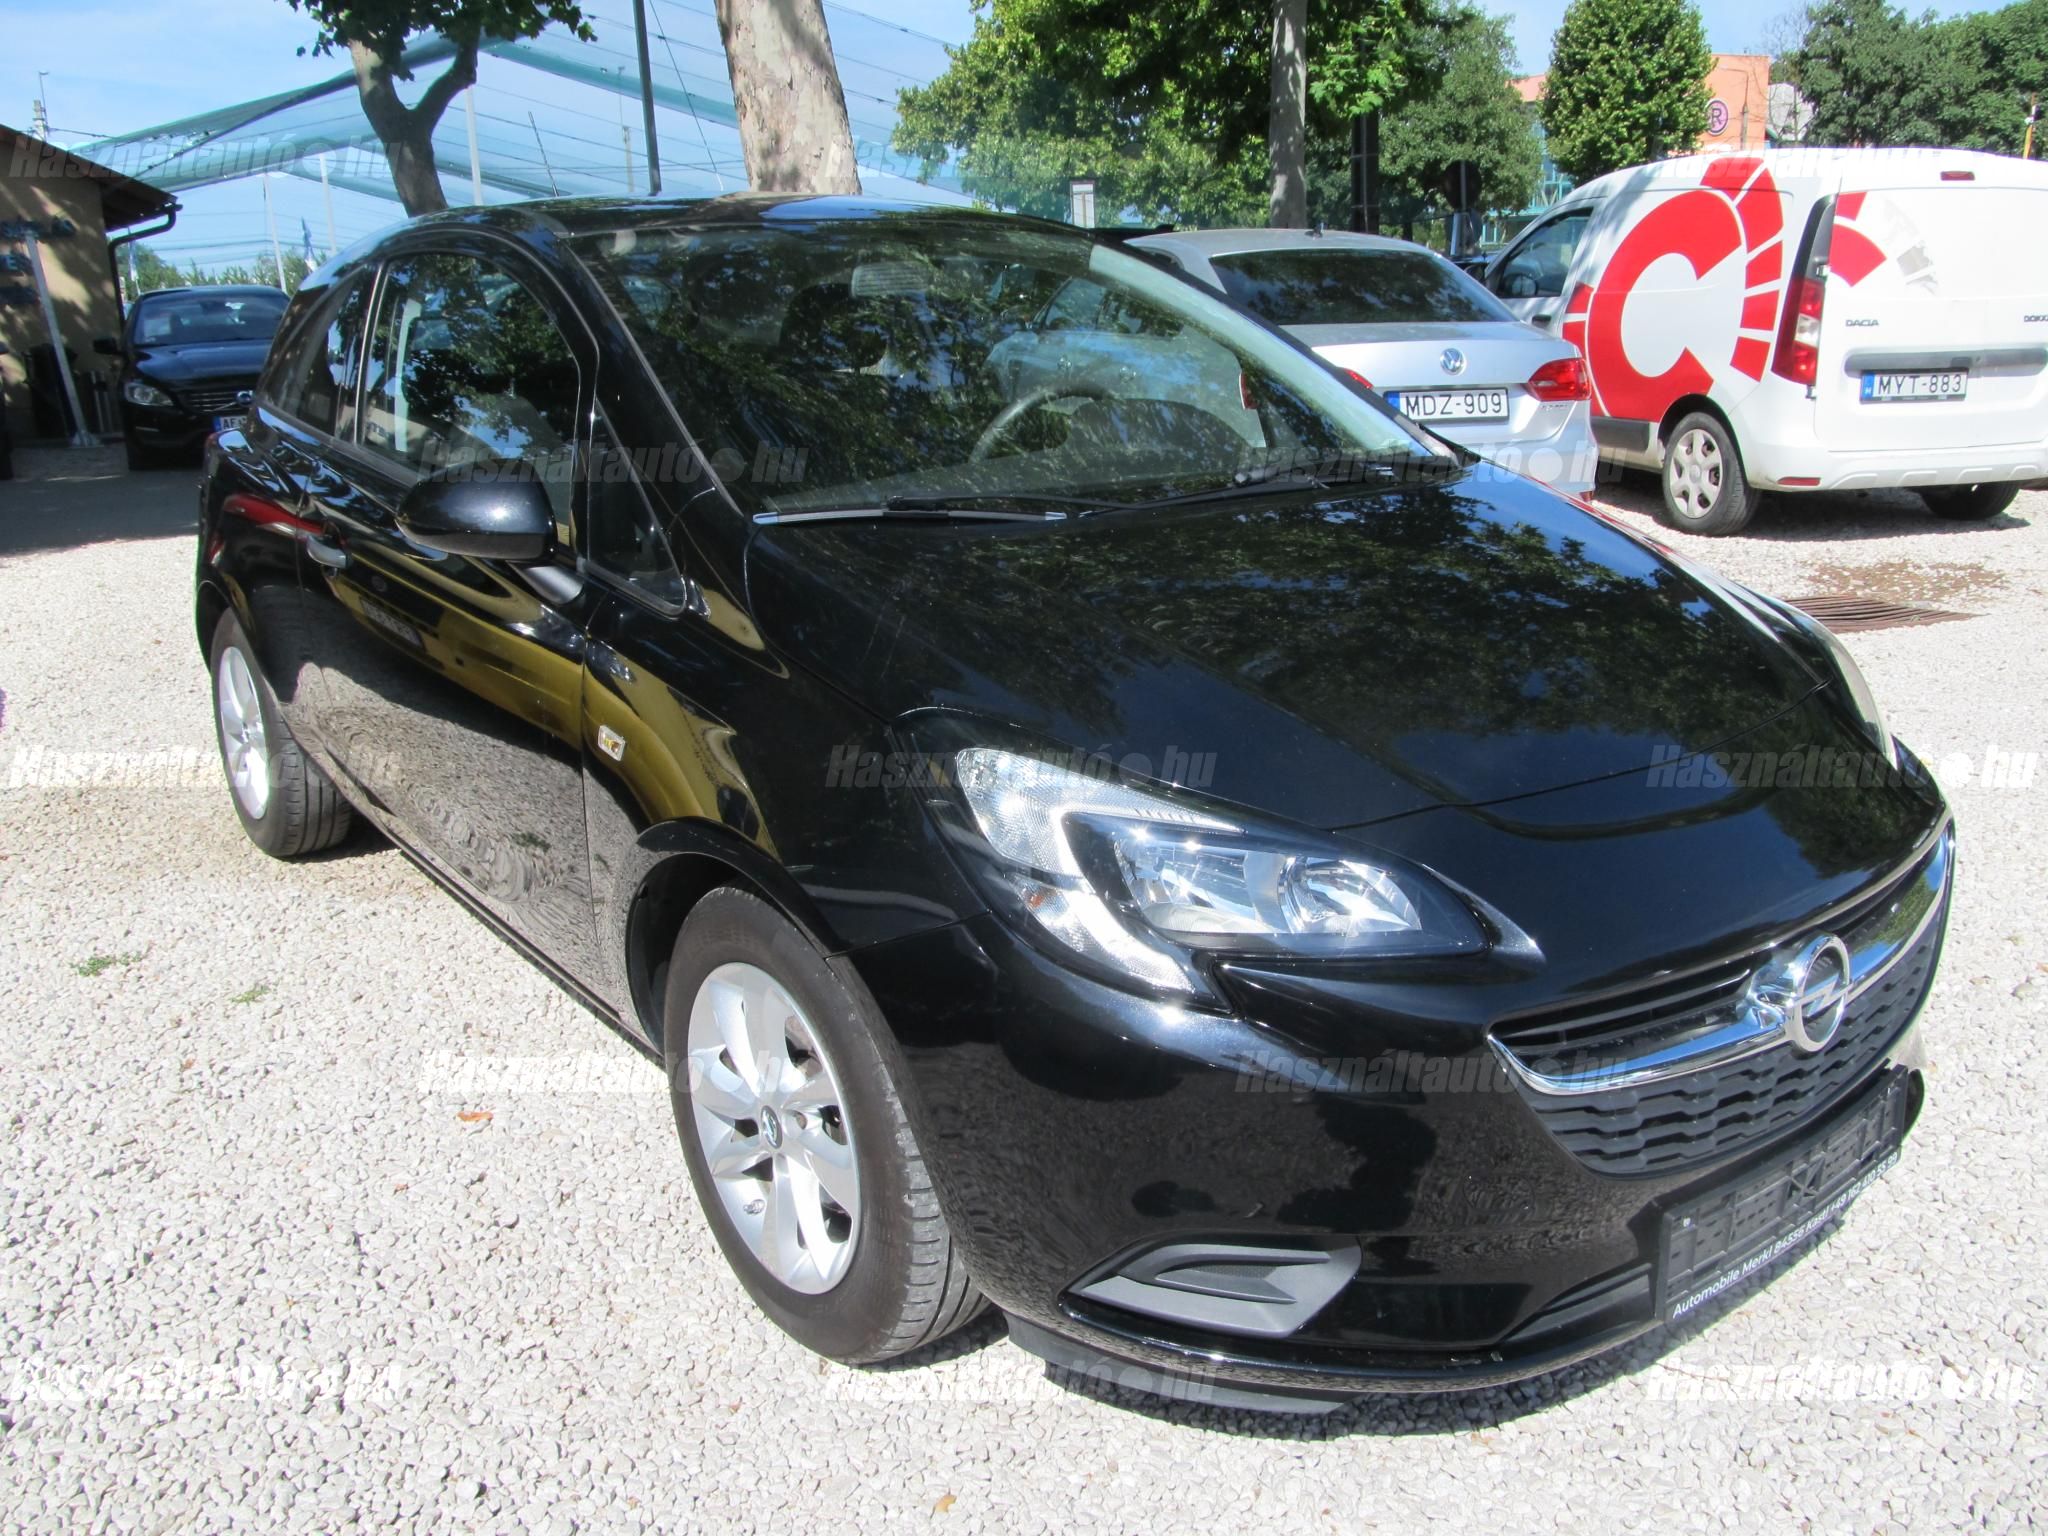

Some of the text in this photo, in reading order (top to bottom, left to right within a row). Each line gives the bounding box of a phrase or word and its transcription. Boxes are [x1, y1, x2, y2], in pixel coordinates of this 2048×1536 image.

[1845, 319, 1879, 327] DACIA
[1878, 374, 1962, 395] MYT-883
[1406, 392, 1502, 417] MDZ-909
[1672, 1268, 1740, 1320] Automobile
[1741, 1247, 1772, 1276] Merkl
